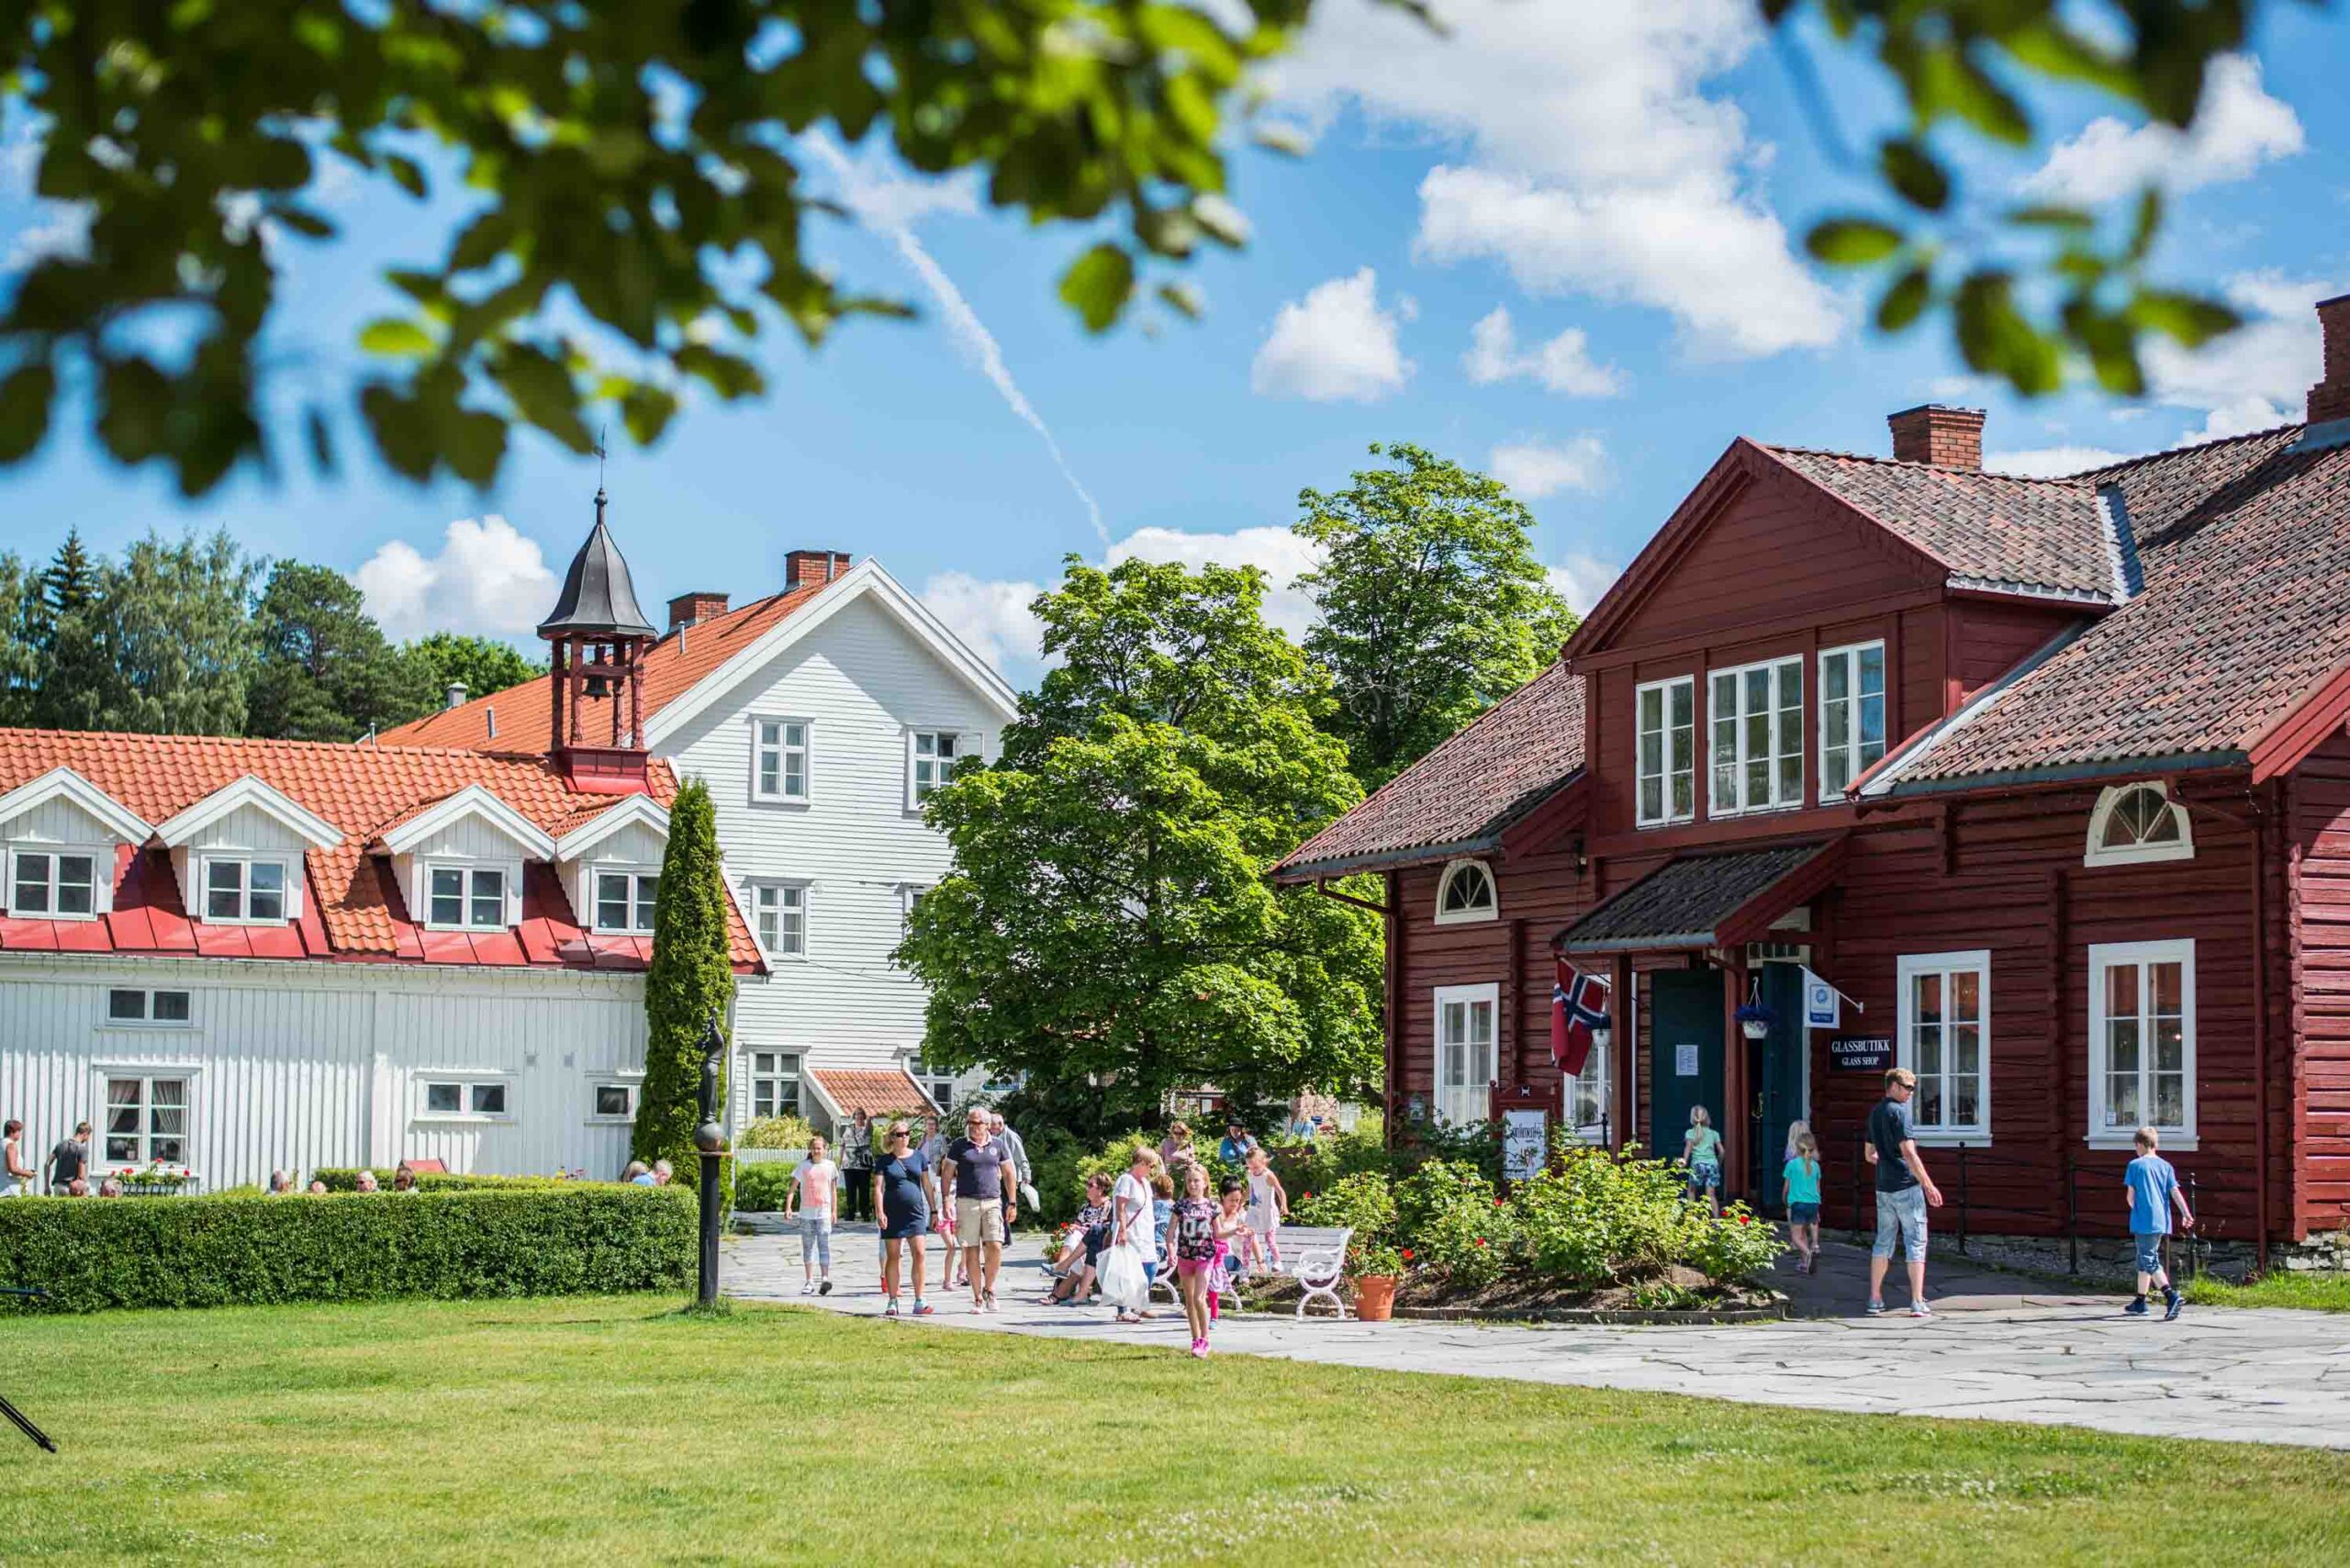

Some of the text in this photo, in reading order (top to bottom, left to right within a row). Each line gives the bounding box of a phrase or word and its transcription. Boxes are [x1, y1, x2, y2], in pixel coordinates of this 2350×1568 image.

[1831, 1039, 1890, 1053] GLASSBUTIKK
[1841, 1056, 1879, 1066] GLASS SHOP
[1183, 1218, 1211, 1238] 04
